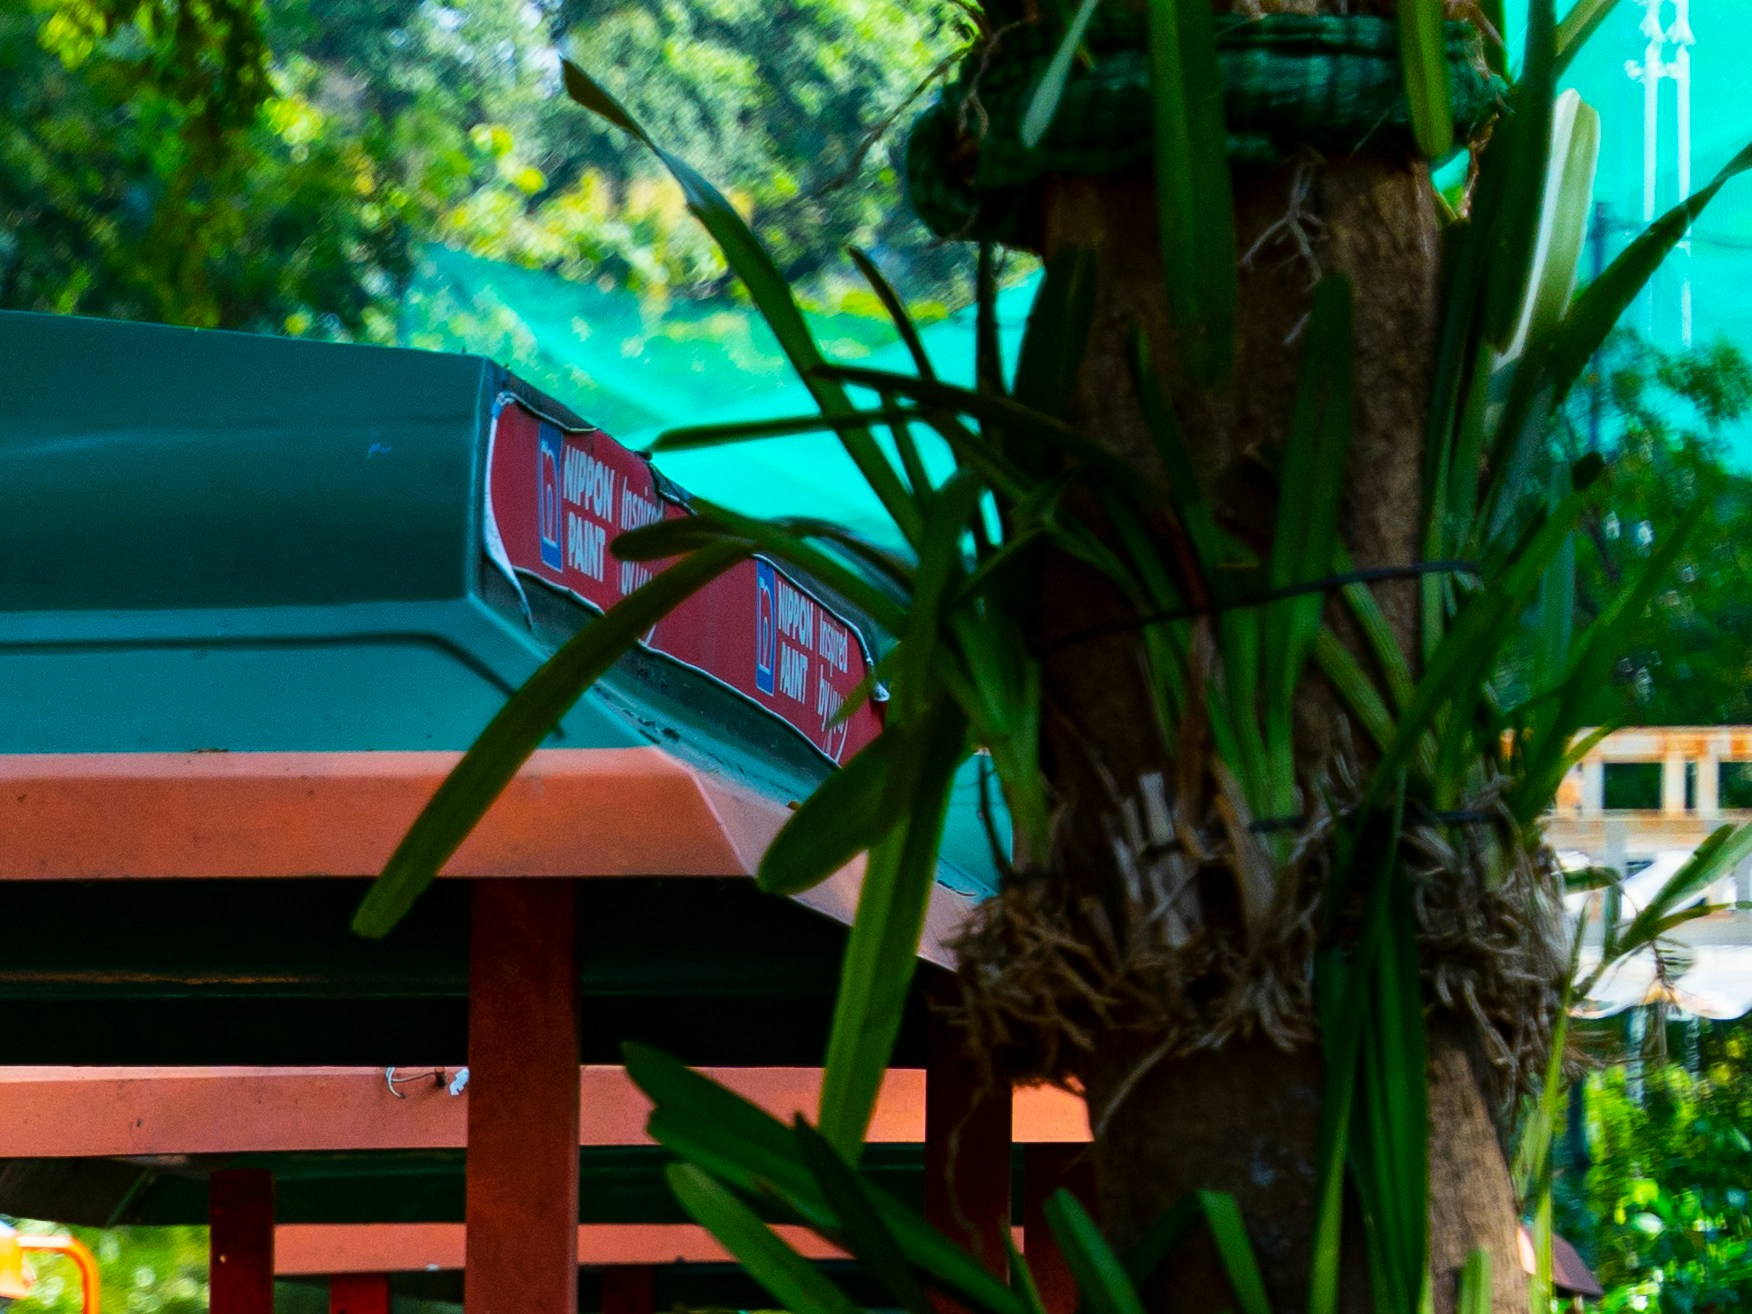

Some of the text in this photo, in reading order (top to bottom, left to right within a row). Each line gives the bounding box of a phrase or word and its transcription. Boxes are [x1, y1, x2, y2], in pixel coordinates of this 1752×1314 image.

[563, 444, 615, 523] NIPPON
[568, 511, 606, 583] PAINT
[777, 580, 814, 650] NIPPON
[779, 641, 809, 705] PAINT
